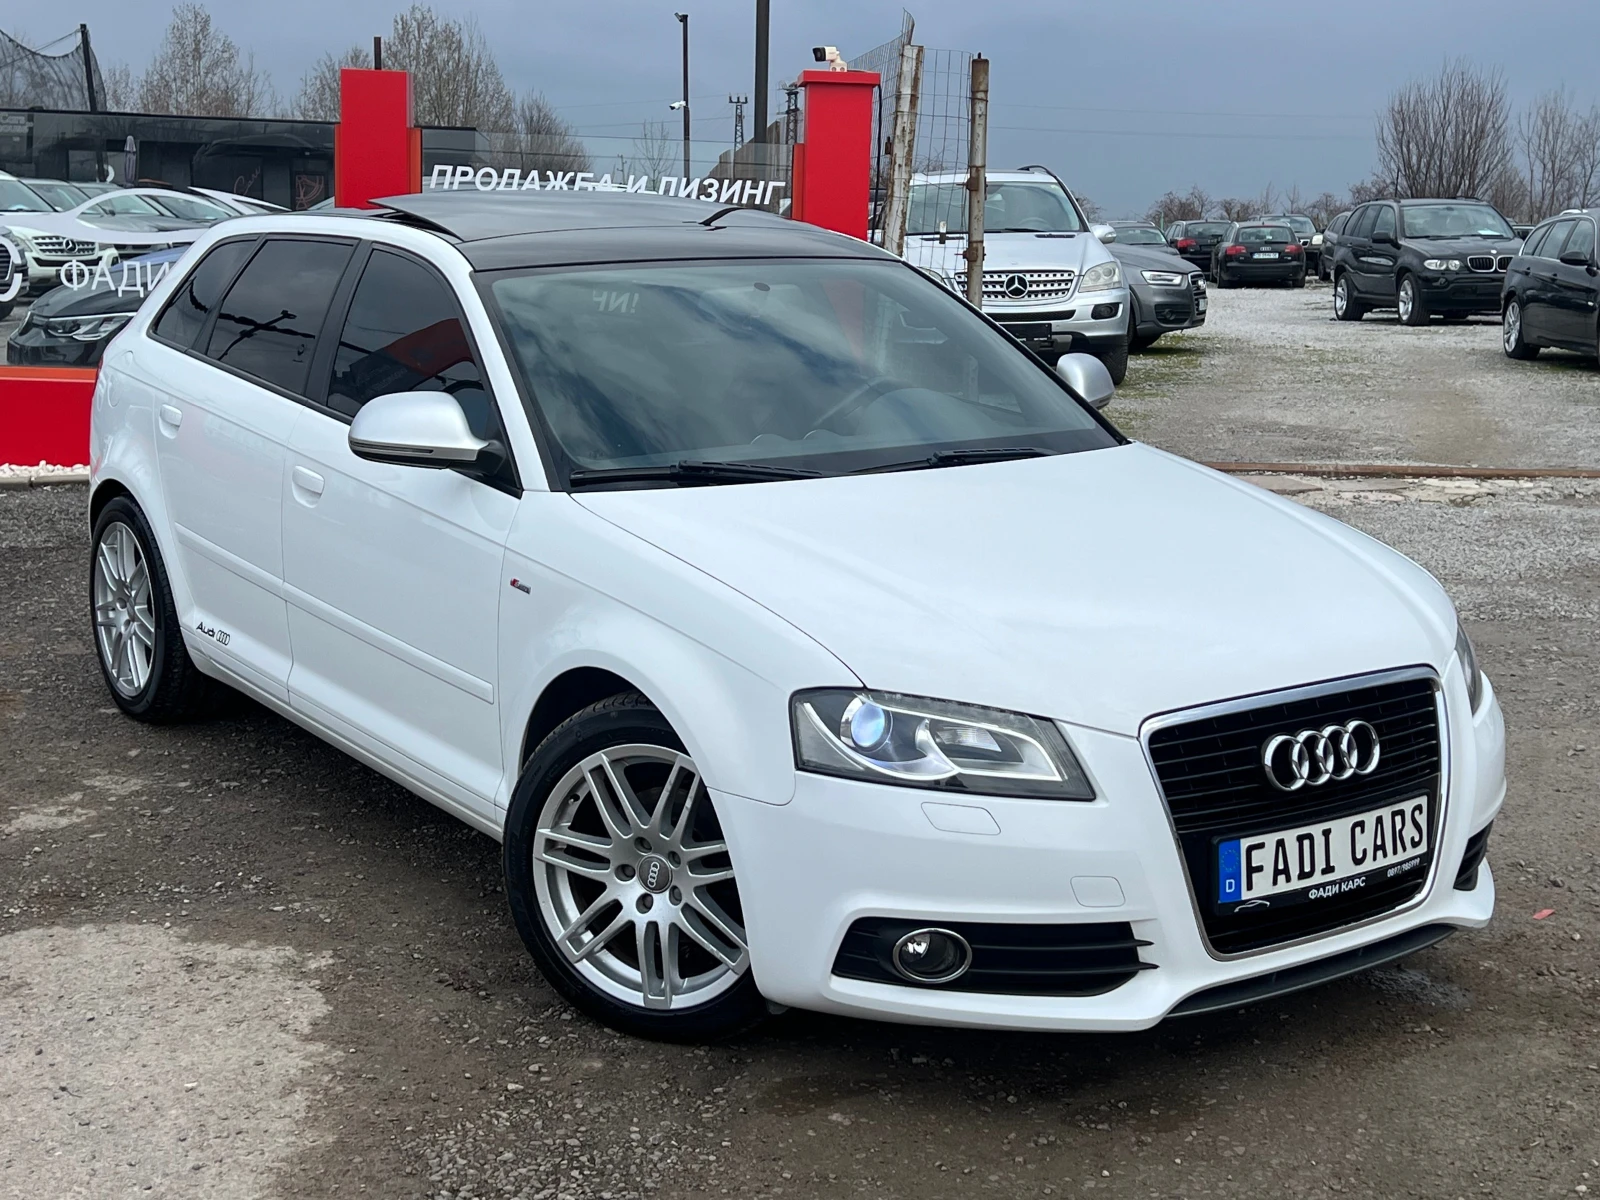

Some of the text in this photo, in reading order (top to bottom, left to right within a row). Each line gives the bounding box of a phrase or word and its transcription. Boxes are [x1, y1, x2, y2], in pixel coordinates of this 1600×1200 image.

[60, 259, 170, 298] ФАДИ
[196, 621, 216, 638] Audi
[1245, 803, 1424, 892] FADI CARS
[1225, 878, 1236, 893] D
[1308, 876, 1366, 899] ФАДИ КАРС
